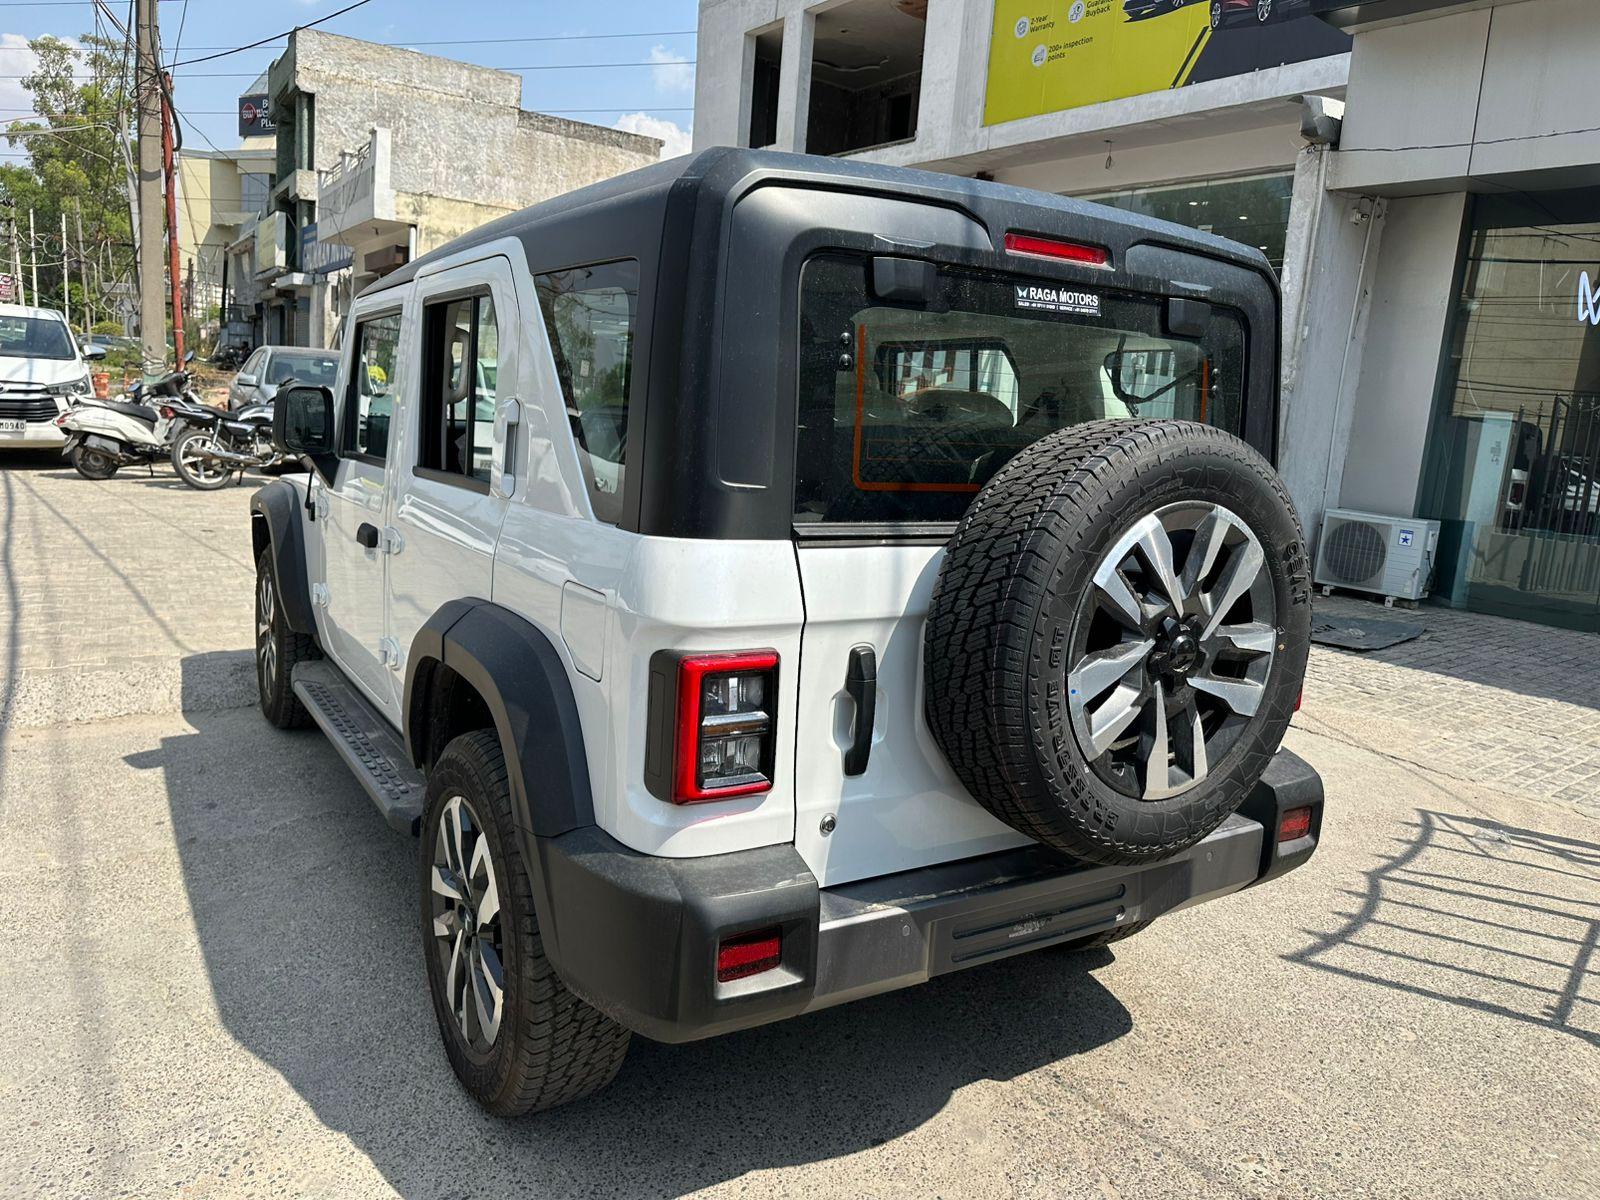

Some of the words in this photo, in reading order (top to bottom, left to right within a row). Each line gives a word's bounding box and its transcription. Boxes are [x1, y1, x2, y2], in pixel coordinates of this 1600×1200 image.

[1086, 5, 1110, 17] Buyback
[1031, 15, 1048, 24] 2-Year
[1030, 22, 1055, 33] Warranty
[1049, 44, 1062, 53] 200+
[1063, 37, 1093, 48] inspection
[1048, 52, 1065, 62] points
[1029, 287, 1058, 302] RAGA
[1060, 289, 1099, 306] MOTORS
